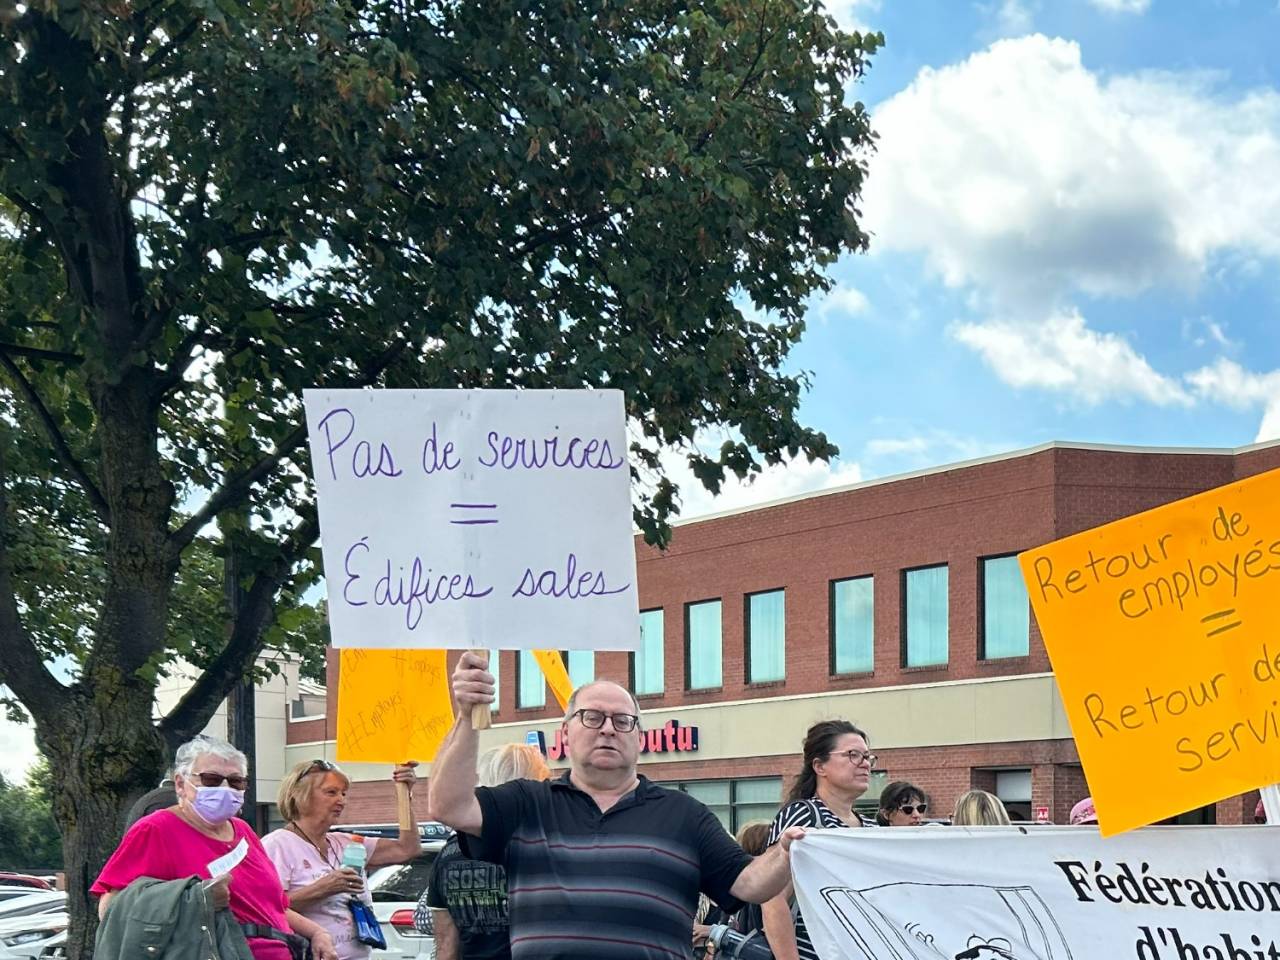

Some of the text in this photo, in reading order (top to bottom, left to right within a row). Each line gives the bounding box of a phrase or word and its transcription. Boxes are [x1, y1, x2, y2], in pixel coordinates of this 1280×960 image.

[318, 408, 624, 480] Pas de services
[343, 536, 630, 630] Édifices sales
[1033, 533, 1173, 603] Retour
[1211, 506, 1250, 541] de
[640, 719, 694, 754] utu
[1084, 671, 1226, 738] Retour
